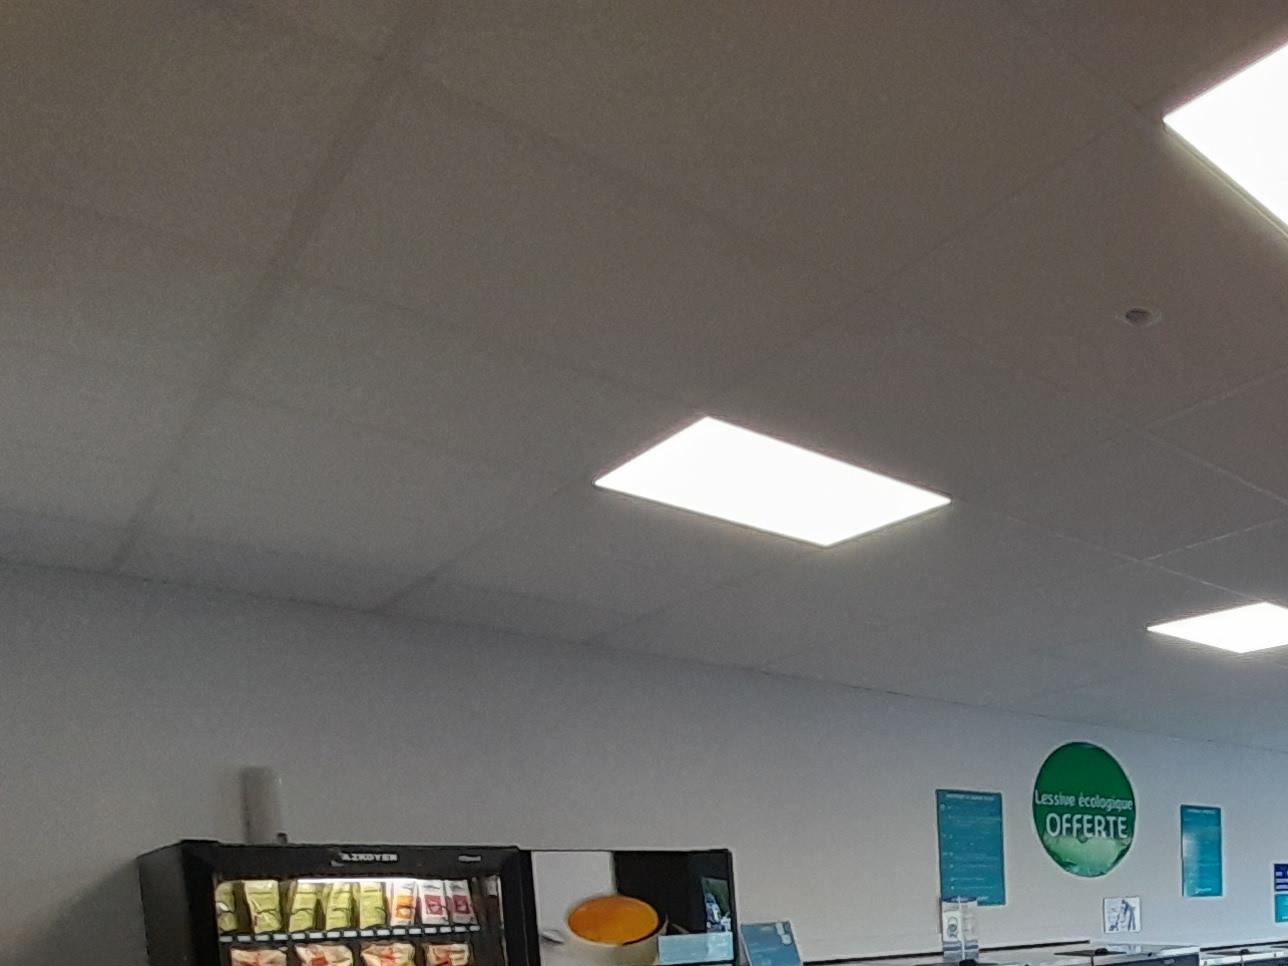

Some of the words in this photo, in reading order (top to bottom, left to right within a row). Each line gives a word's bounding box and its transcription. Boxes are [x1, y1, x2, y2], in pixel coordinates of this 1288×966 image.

[1035, 789, 1076, 807] Lessive
[1078, 792, 1133, 812] écologique
[1046, 812, 1128, 838] OFFERTE
